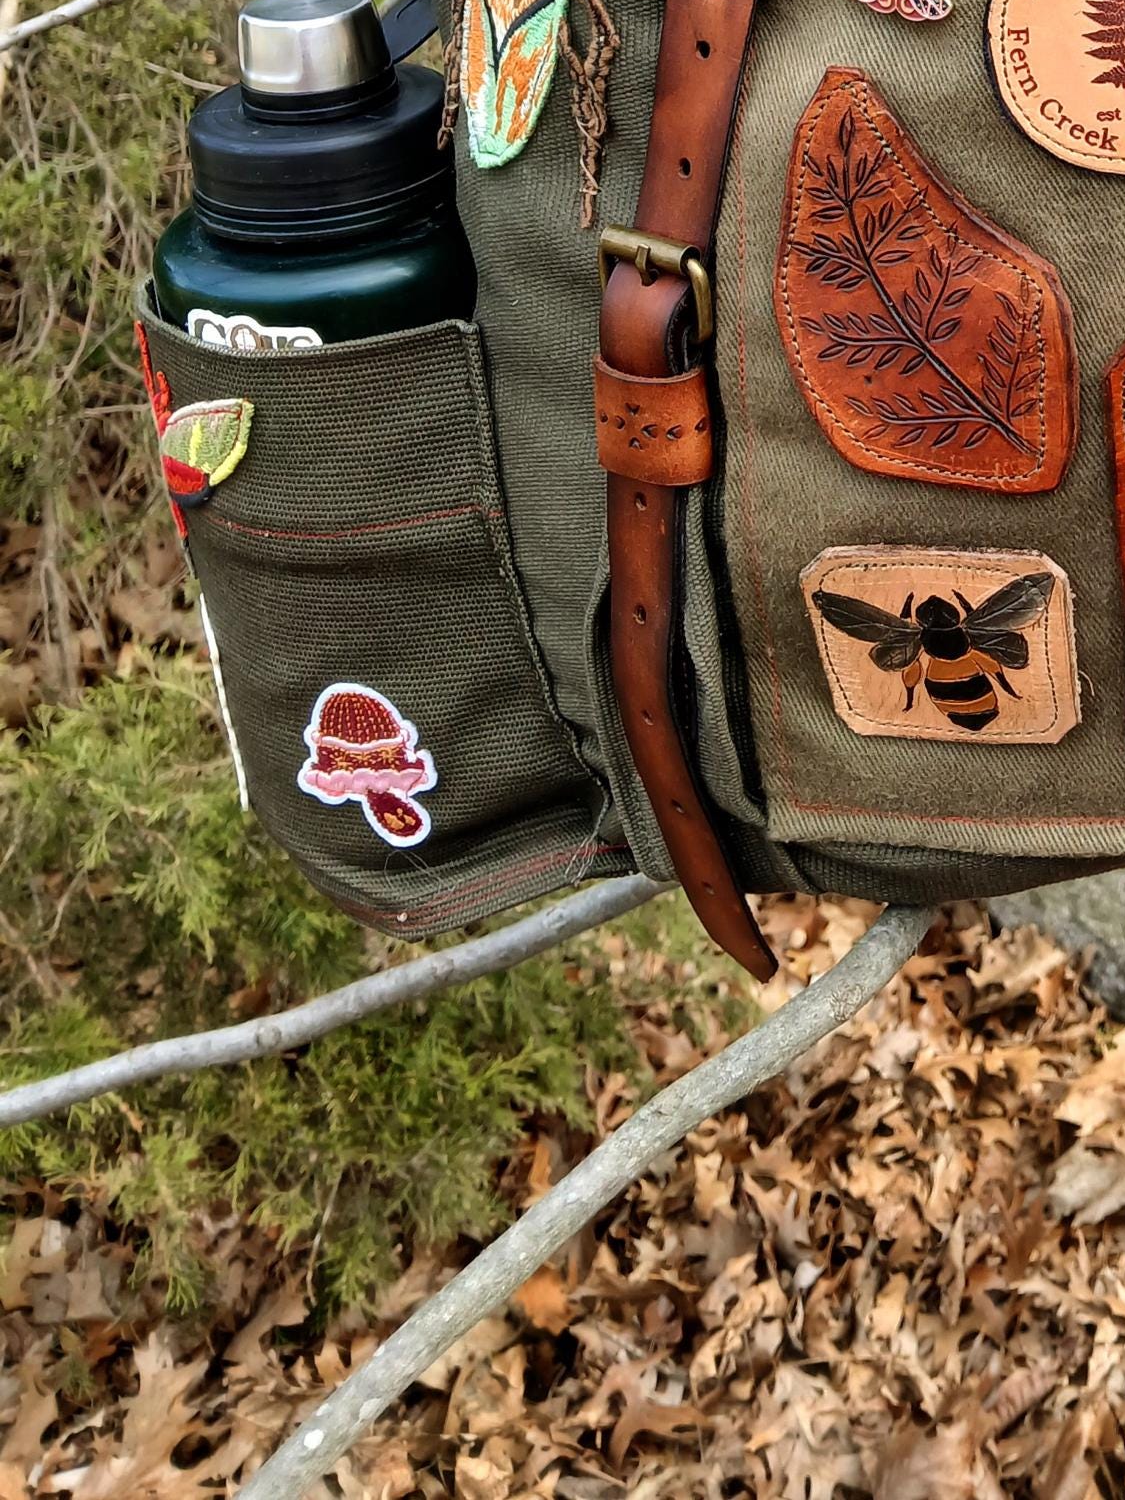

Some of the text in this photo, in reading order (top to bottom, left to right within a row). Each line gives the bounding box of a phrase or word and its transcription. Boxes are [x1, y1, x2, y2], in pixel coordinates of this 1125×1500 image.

[1007, 27, 1039, 96] Fern
[1039, 98, 1120, 152] Creek
[1096, 106, 1122, 122] est
